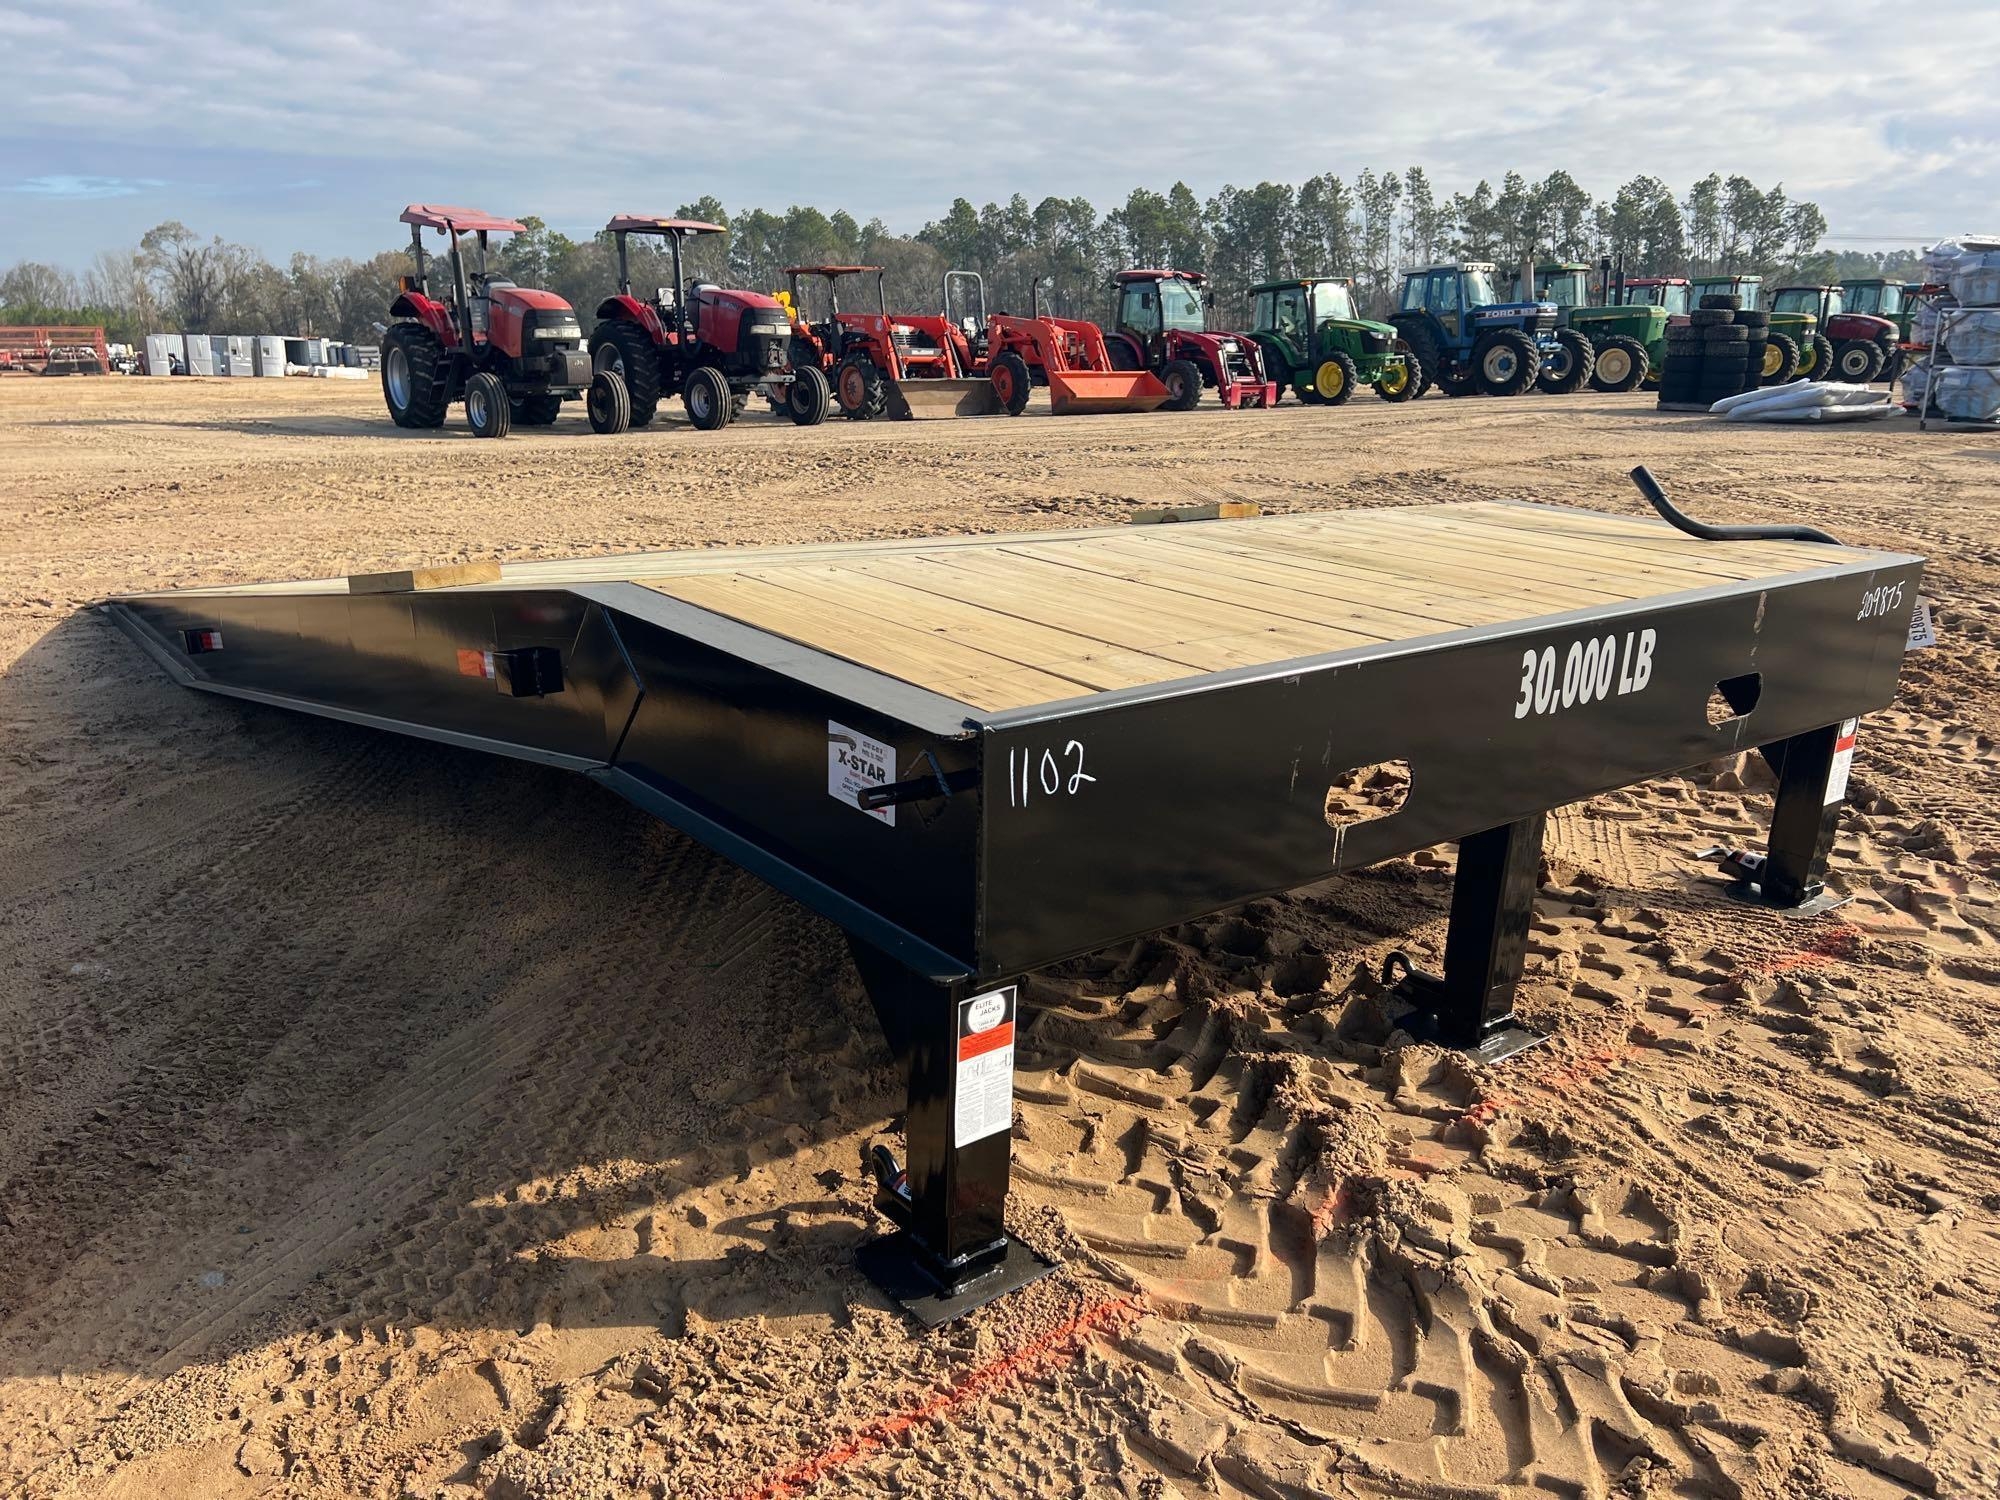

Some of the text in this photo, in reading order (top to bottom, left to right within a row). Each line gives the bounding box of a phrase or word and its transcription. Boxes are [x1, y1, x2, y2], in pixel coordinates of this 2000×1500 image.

[1485, 310, 1515, 318] FORD
[1857, 581, 1905, 621] 209875
[1514, 628, 1656, 719] 30,000 LB
[838, 748, 886, 784] X-STAR
[1009, 739, 1096, 807] 1102
[975, 1000, 993, 1010] ELITE
[980, 1005, 1001, 1016] JACKS
